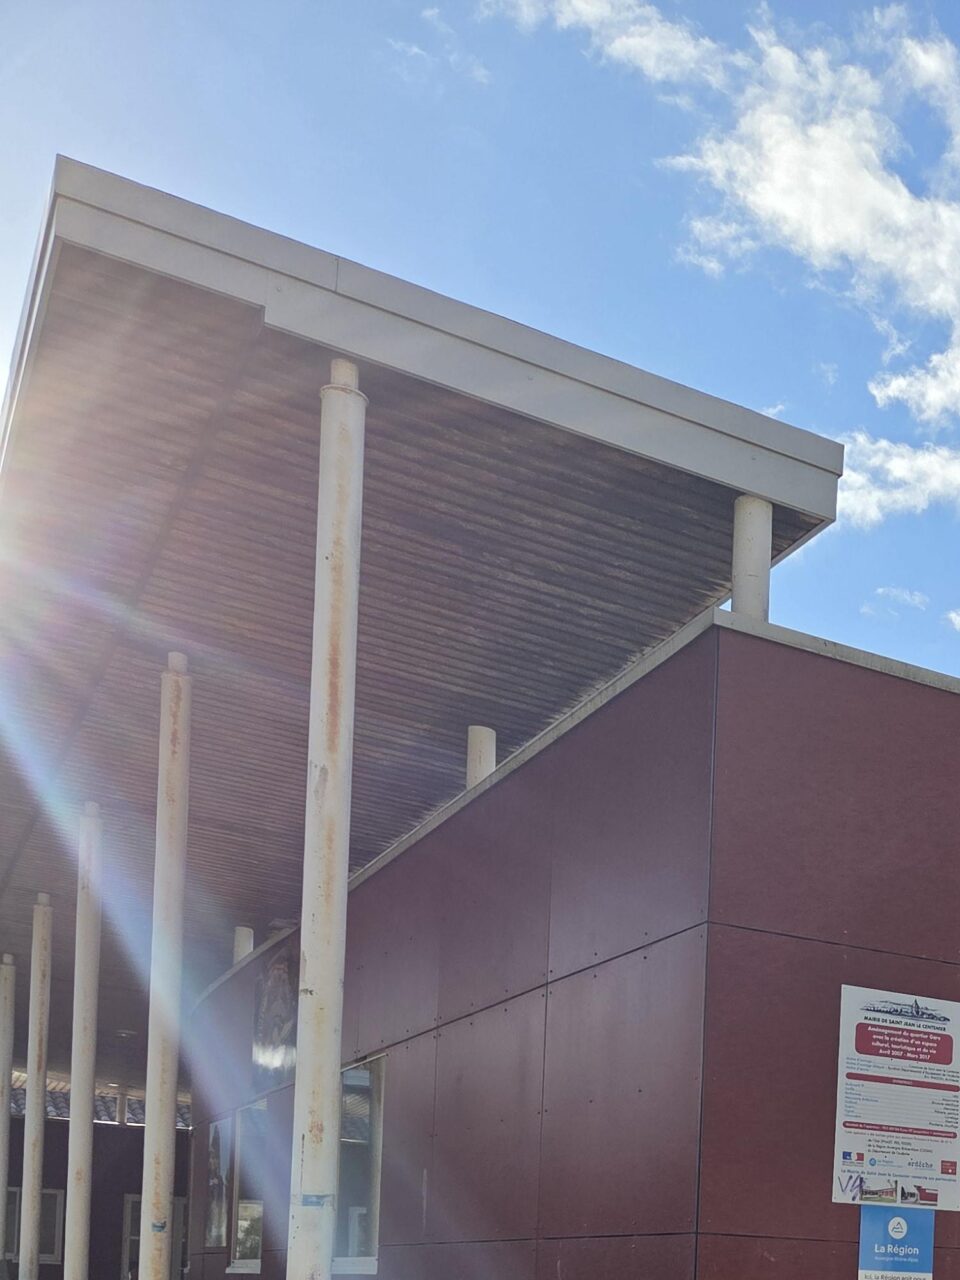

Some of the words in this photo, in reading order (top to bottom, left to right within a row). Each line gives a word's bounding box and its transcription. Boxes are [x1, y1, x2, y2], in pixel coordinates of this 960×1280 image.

[910, 1031, 928, 1039] quartier
[874, 1244, 886, 1253] La
[887, 1244, 919, 1256] Région
